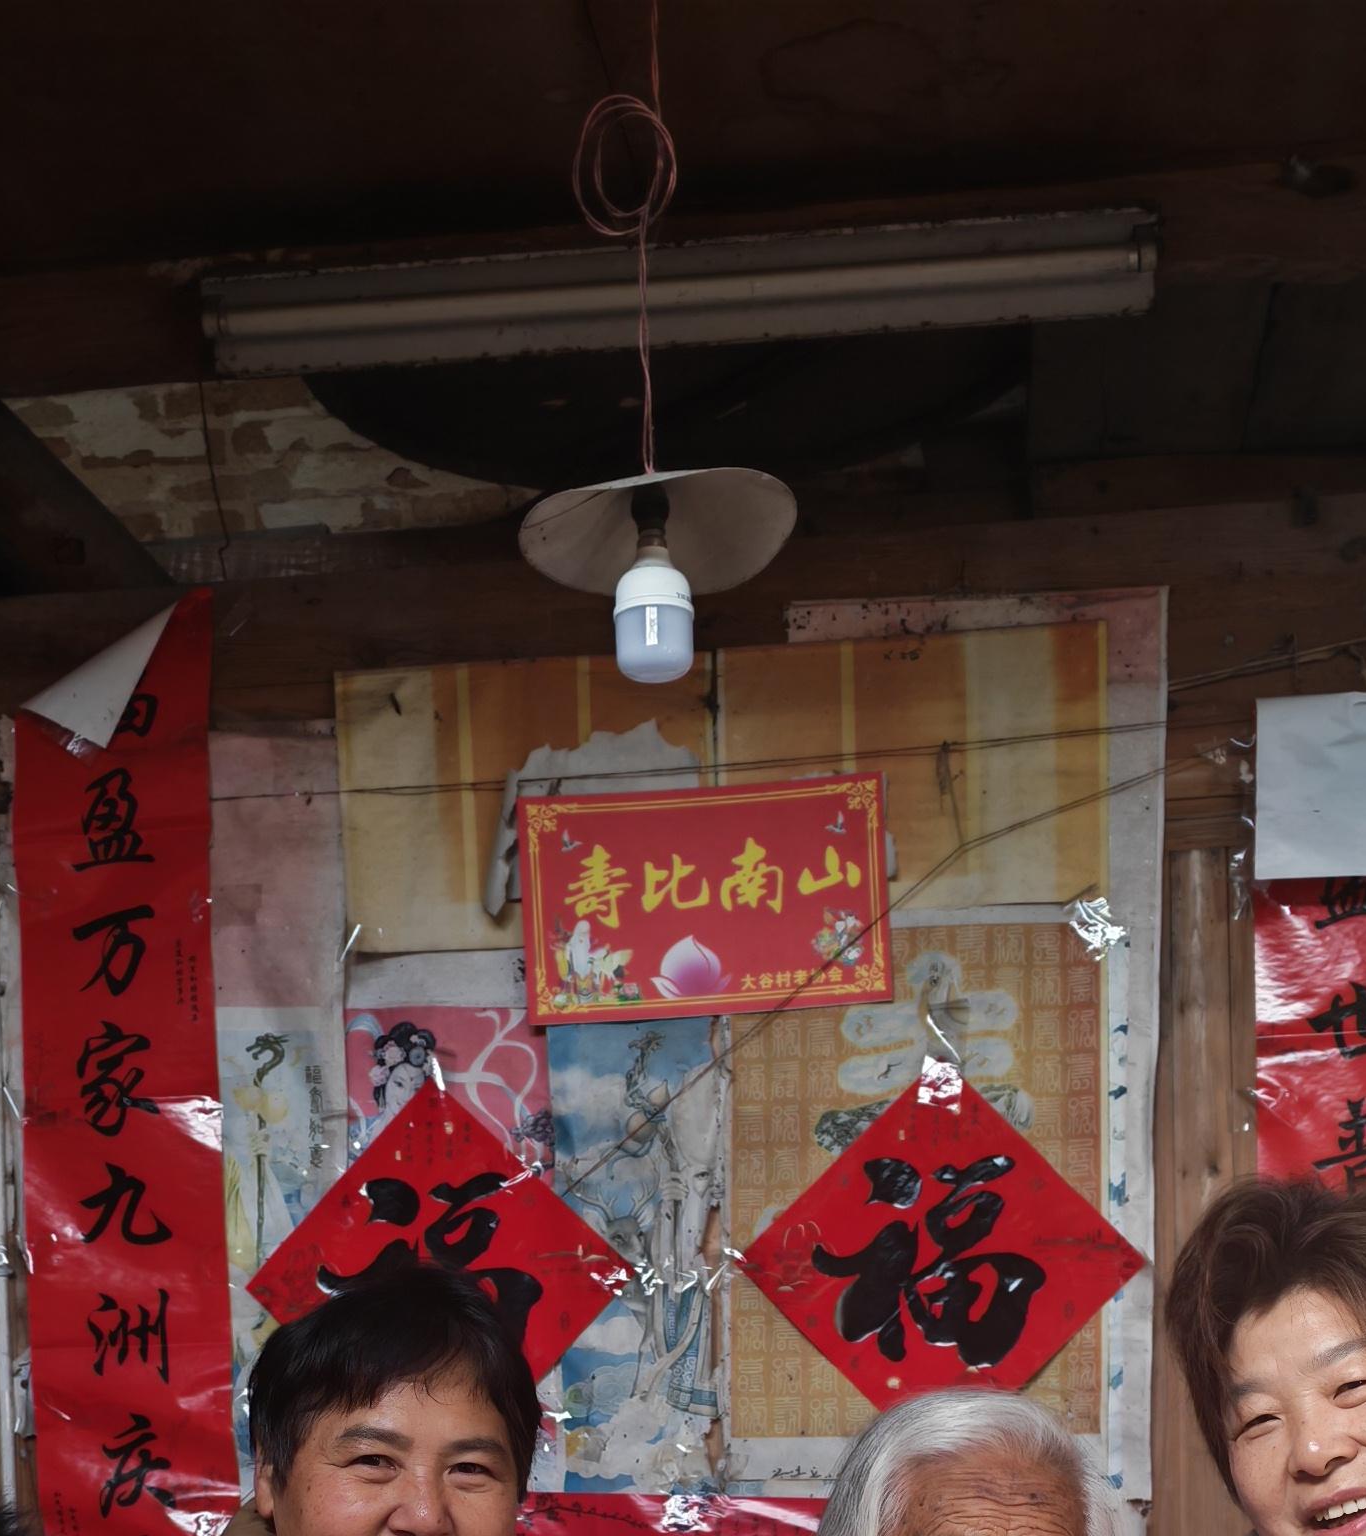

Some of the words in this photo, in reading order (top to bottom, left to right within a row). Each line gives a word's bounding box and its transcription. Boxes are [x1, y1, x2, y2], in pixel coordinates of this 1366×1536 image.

[563, 836, 861, 929] 寿比南山
[810, 1155, 1048, 1369] 福
